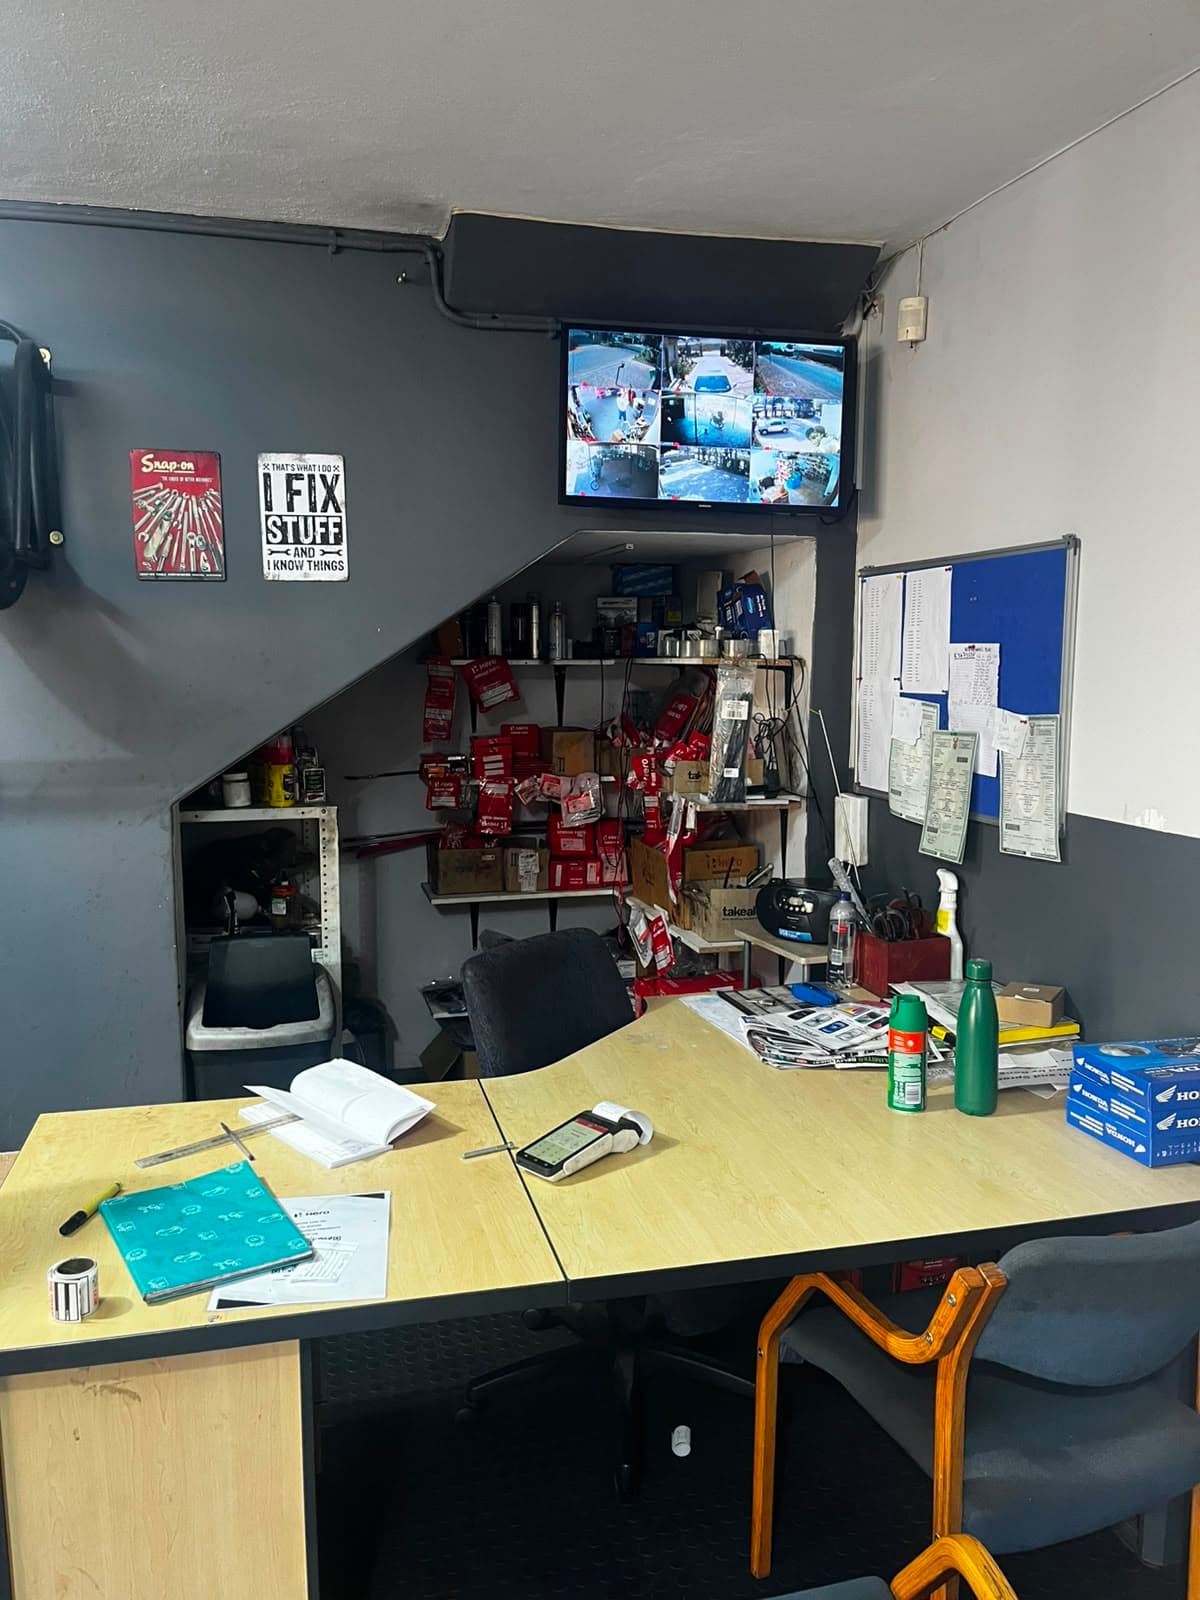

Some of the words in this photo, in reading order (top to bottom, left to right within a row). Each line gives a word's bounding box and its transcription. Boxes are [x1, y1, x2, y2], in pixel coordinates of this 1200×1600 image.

[141, 453, 195, 473] Snap-on
[272, 463, 296, 472] THAT'S
[297, 464, 317, 472] WHAT
[263, 472, 273, 512] I
[286, 473, 342, 513] FIX
[267, 515, 342, 544] STUFF
[294, 547, 315, 558] AND
[267, 559, 271, 571] I
[273, 560, 304, 571] KNOW
[307, 560, 345, 571] THINGS
[1084, 1062, 1110, 1081] HONDA
[1081, 1089, 1108, 1108] HONDA
[1176, 1118, 1200, 1129] HO
[1105, 1123, 1136, 1148] HONDA
